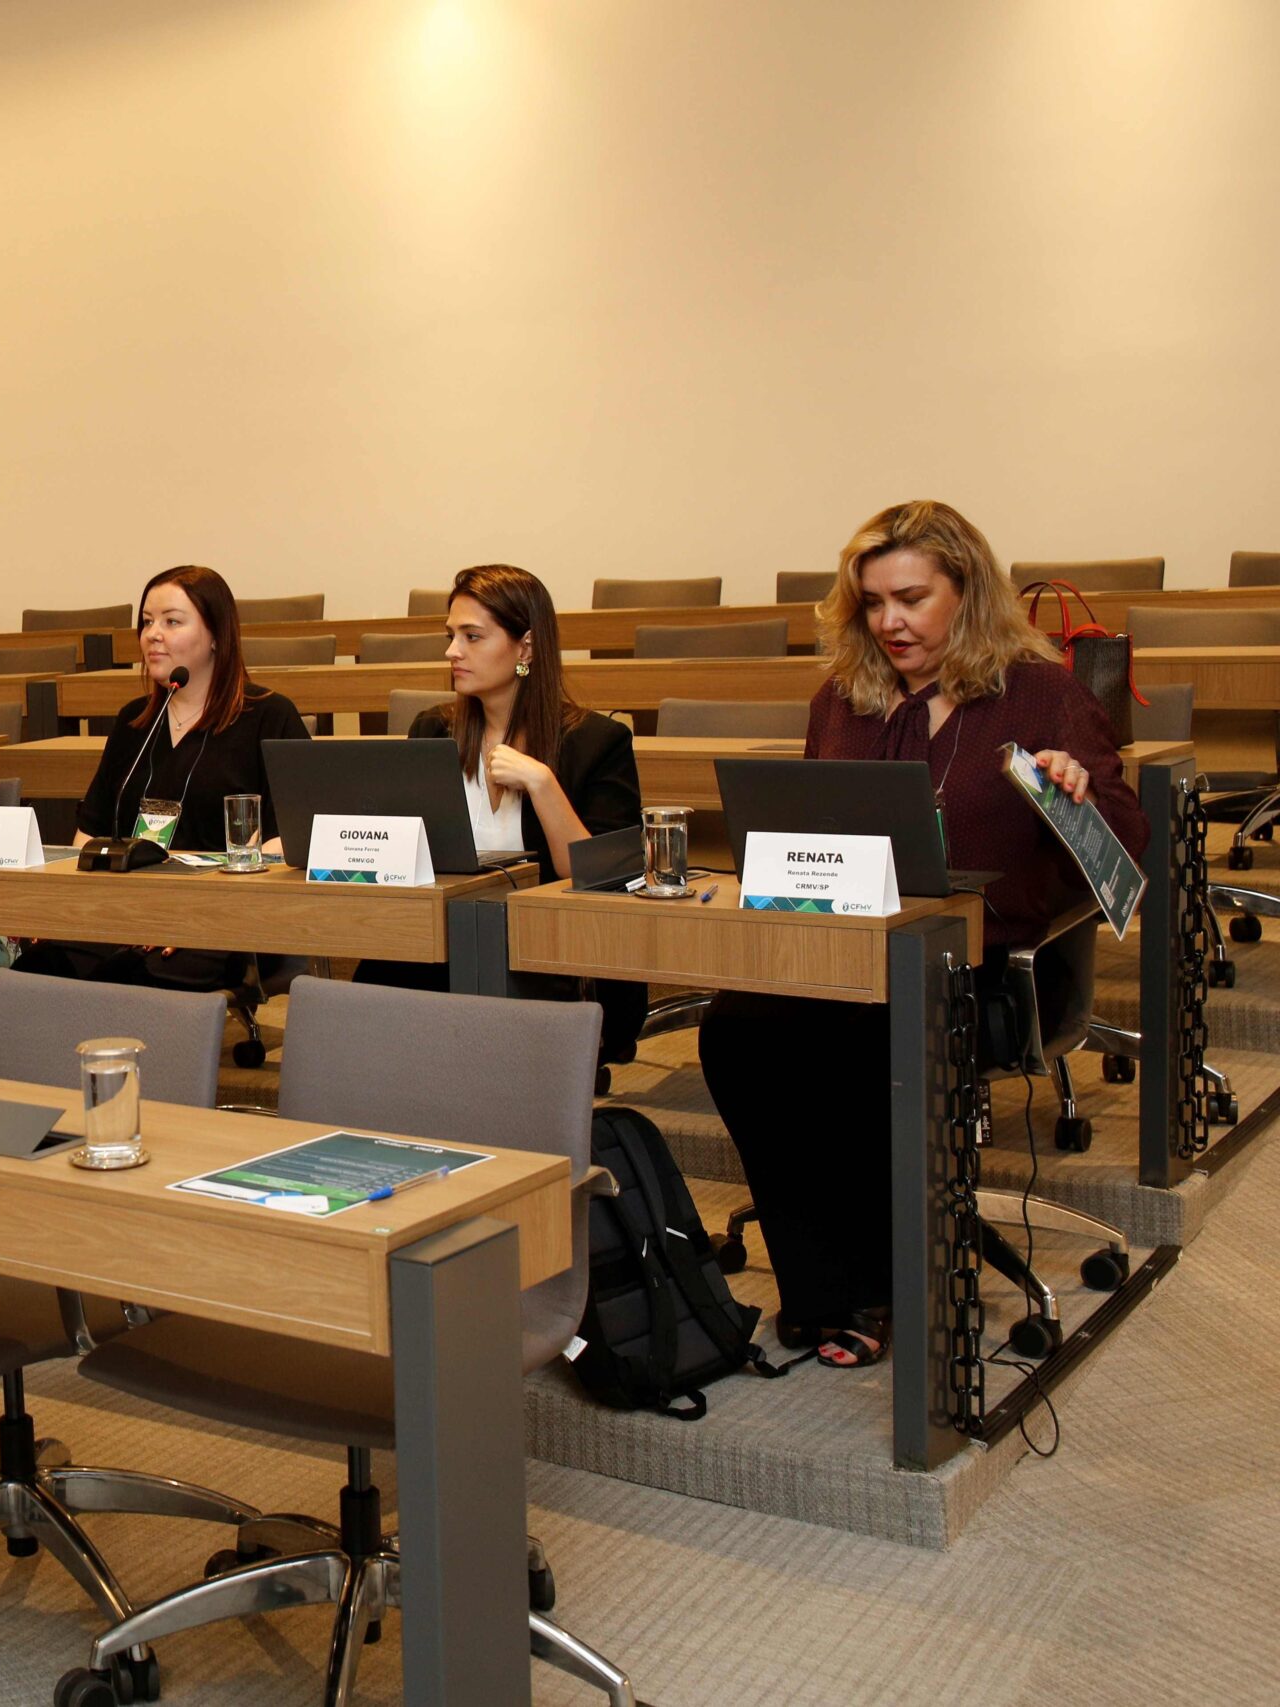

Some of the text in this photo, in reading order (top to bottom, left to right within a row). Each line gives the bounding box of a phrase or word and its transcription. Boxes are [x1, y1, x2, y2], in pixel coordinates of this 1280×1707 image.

[339, 830, 389, 840] GIOVANA
[786, 851, 844, 864] RENATA
[850, 903, 872, 911] CFMV
